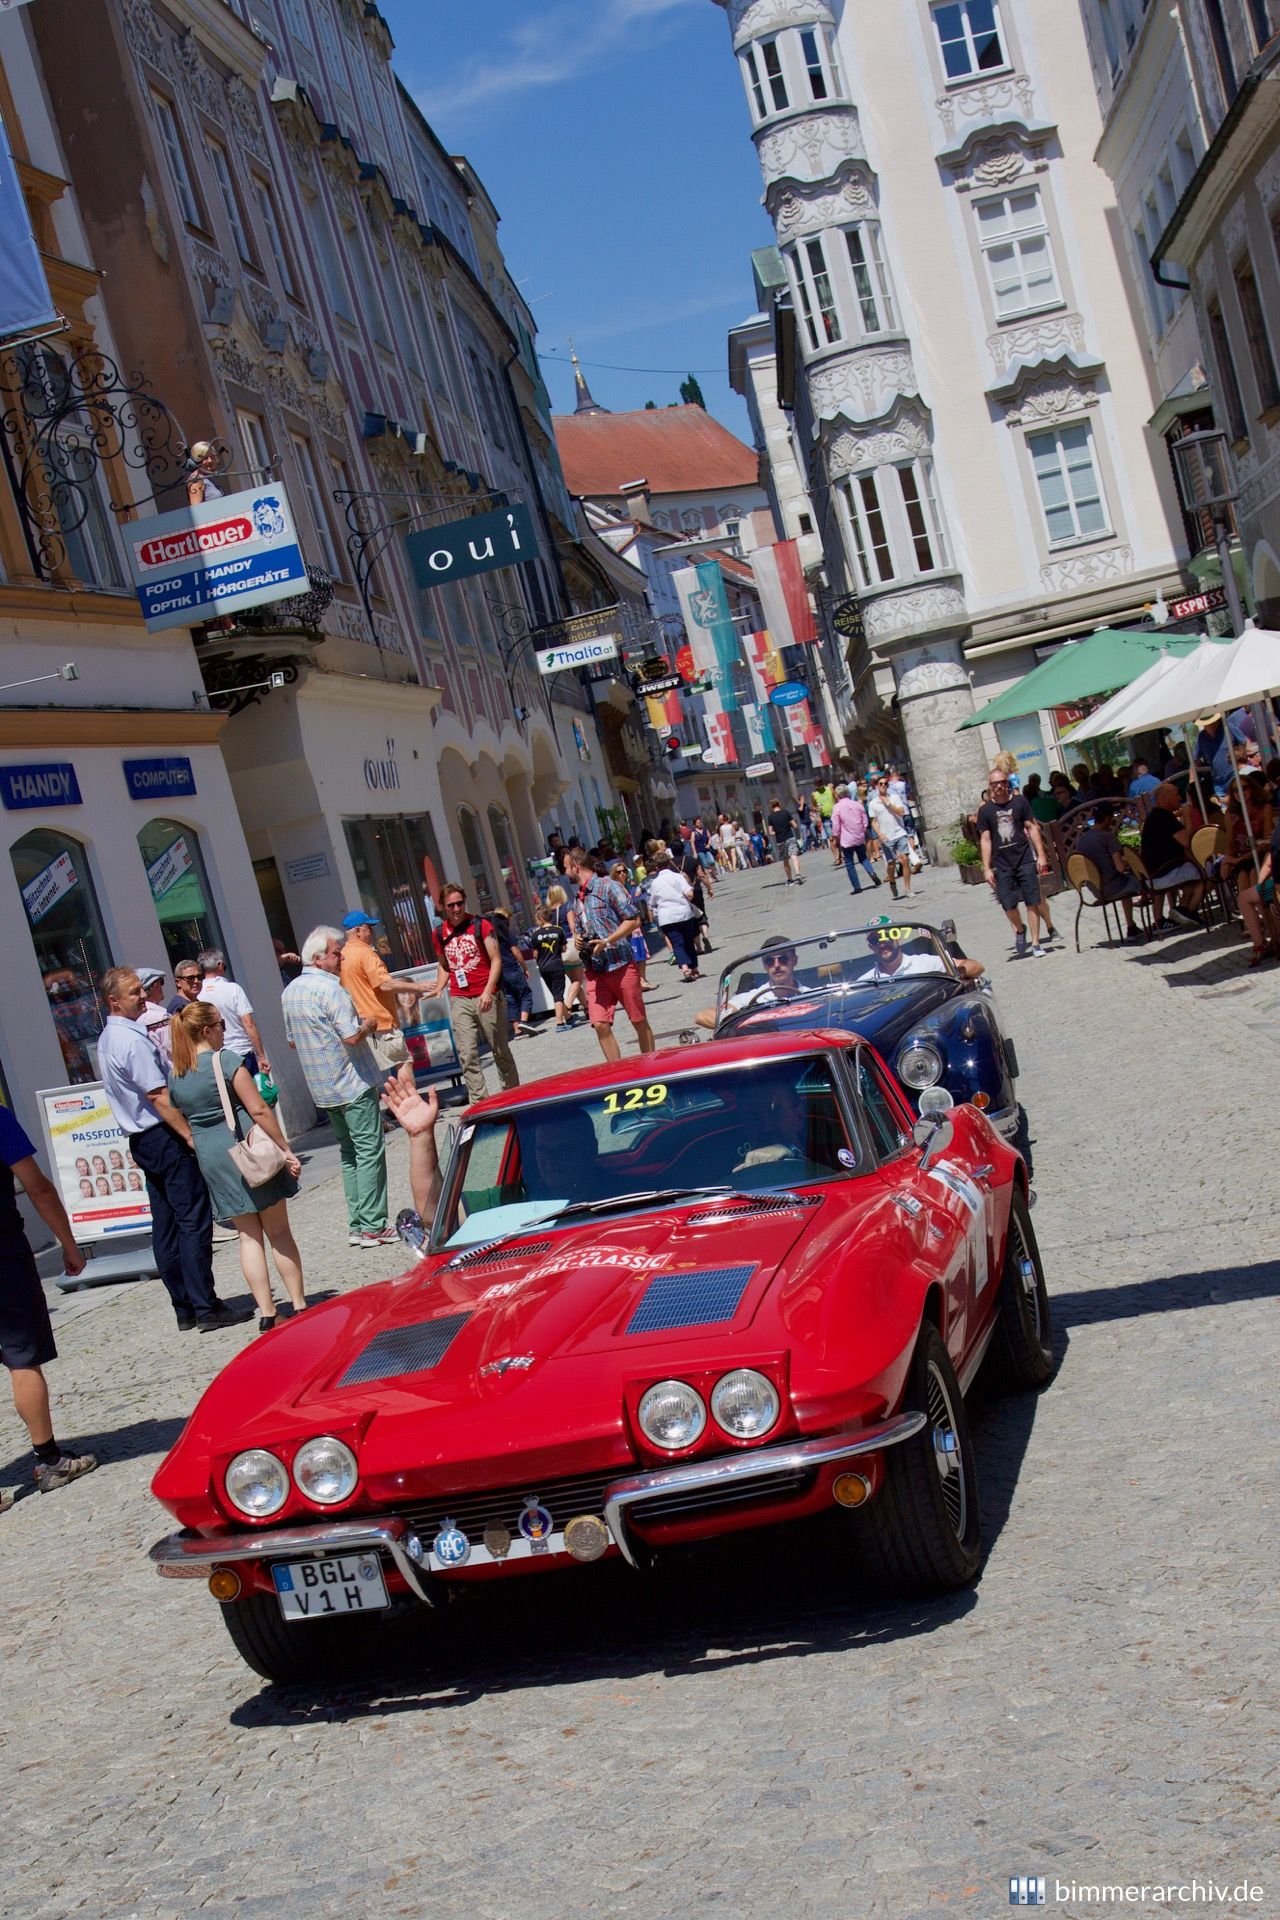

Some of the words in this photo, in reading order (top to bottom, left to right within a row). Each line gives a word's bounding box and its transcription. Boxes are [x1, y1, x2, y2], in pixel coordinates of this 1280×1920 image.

[148, 524, 246, 563] Hartlauer
[146, 579, 182, 597] FOTO
[204, 559, 252, 581] HANDY
[150, 595, 192, 613] OPTIK
[206, 568, 290, 599] HÖRGERÄTE
[1175, 590, 1226, 617] ESPRESS
[10, 773, 70, 799] HANDY
[133, 769, 190, 788] COMPUTER
[40, 882, 60, 914] Internet.
[878, 927, 912, 941] 107
[602, 1084, 667, 1115] 129
[301, 1561, 356, 1588] BGL
[295, 1592, 309, 1615] V
[319, 1590, 336, 1612] 1
[344, 1586, 363, 1609] H
